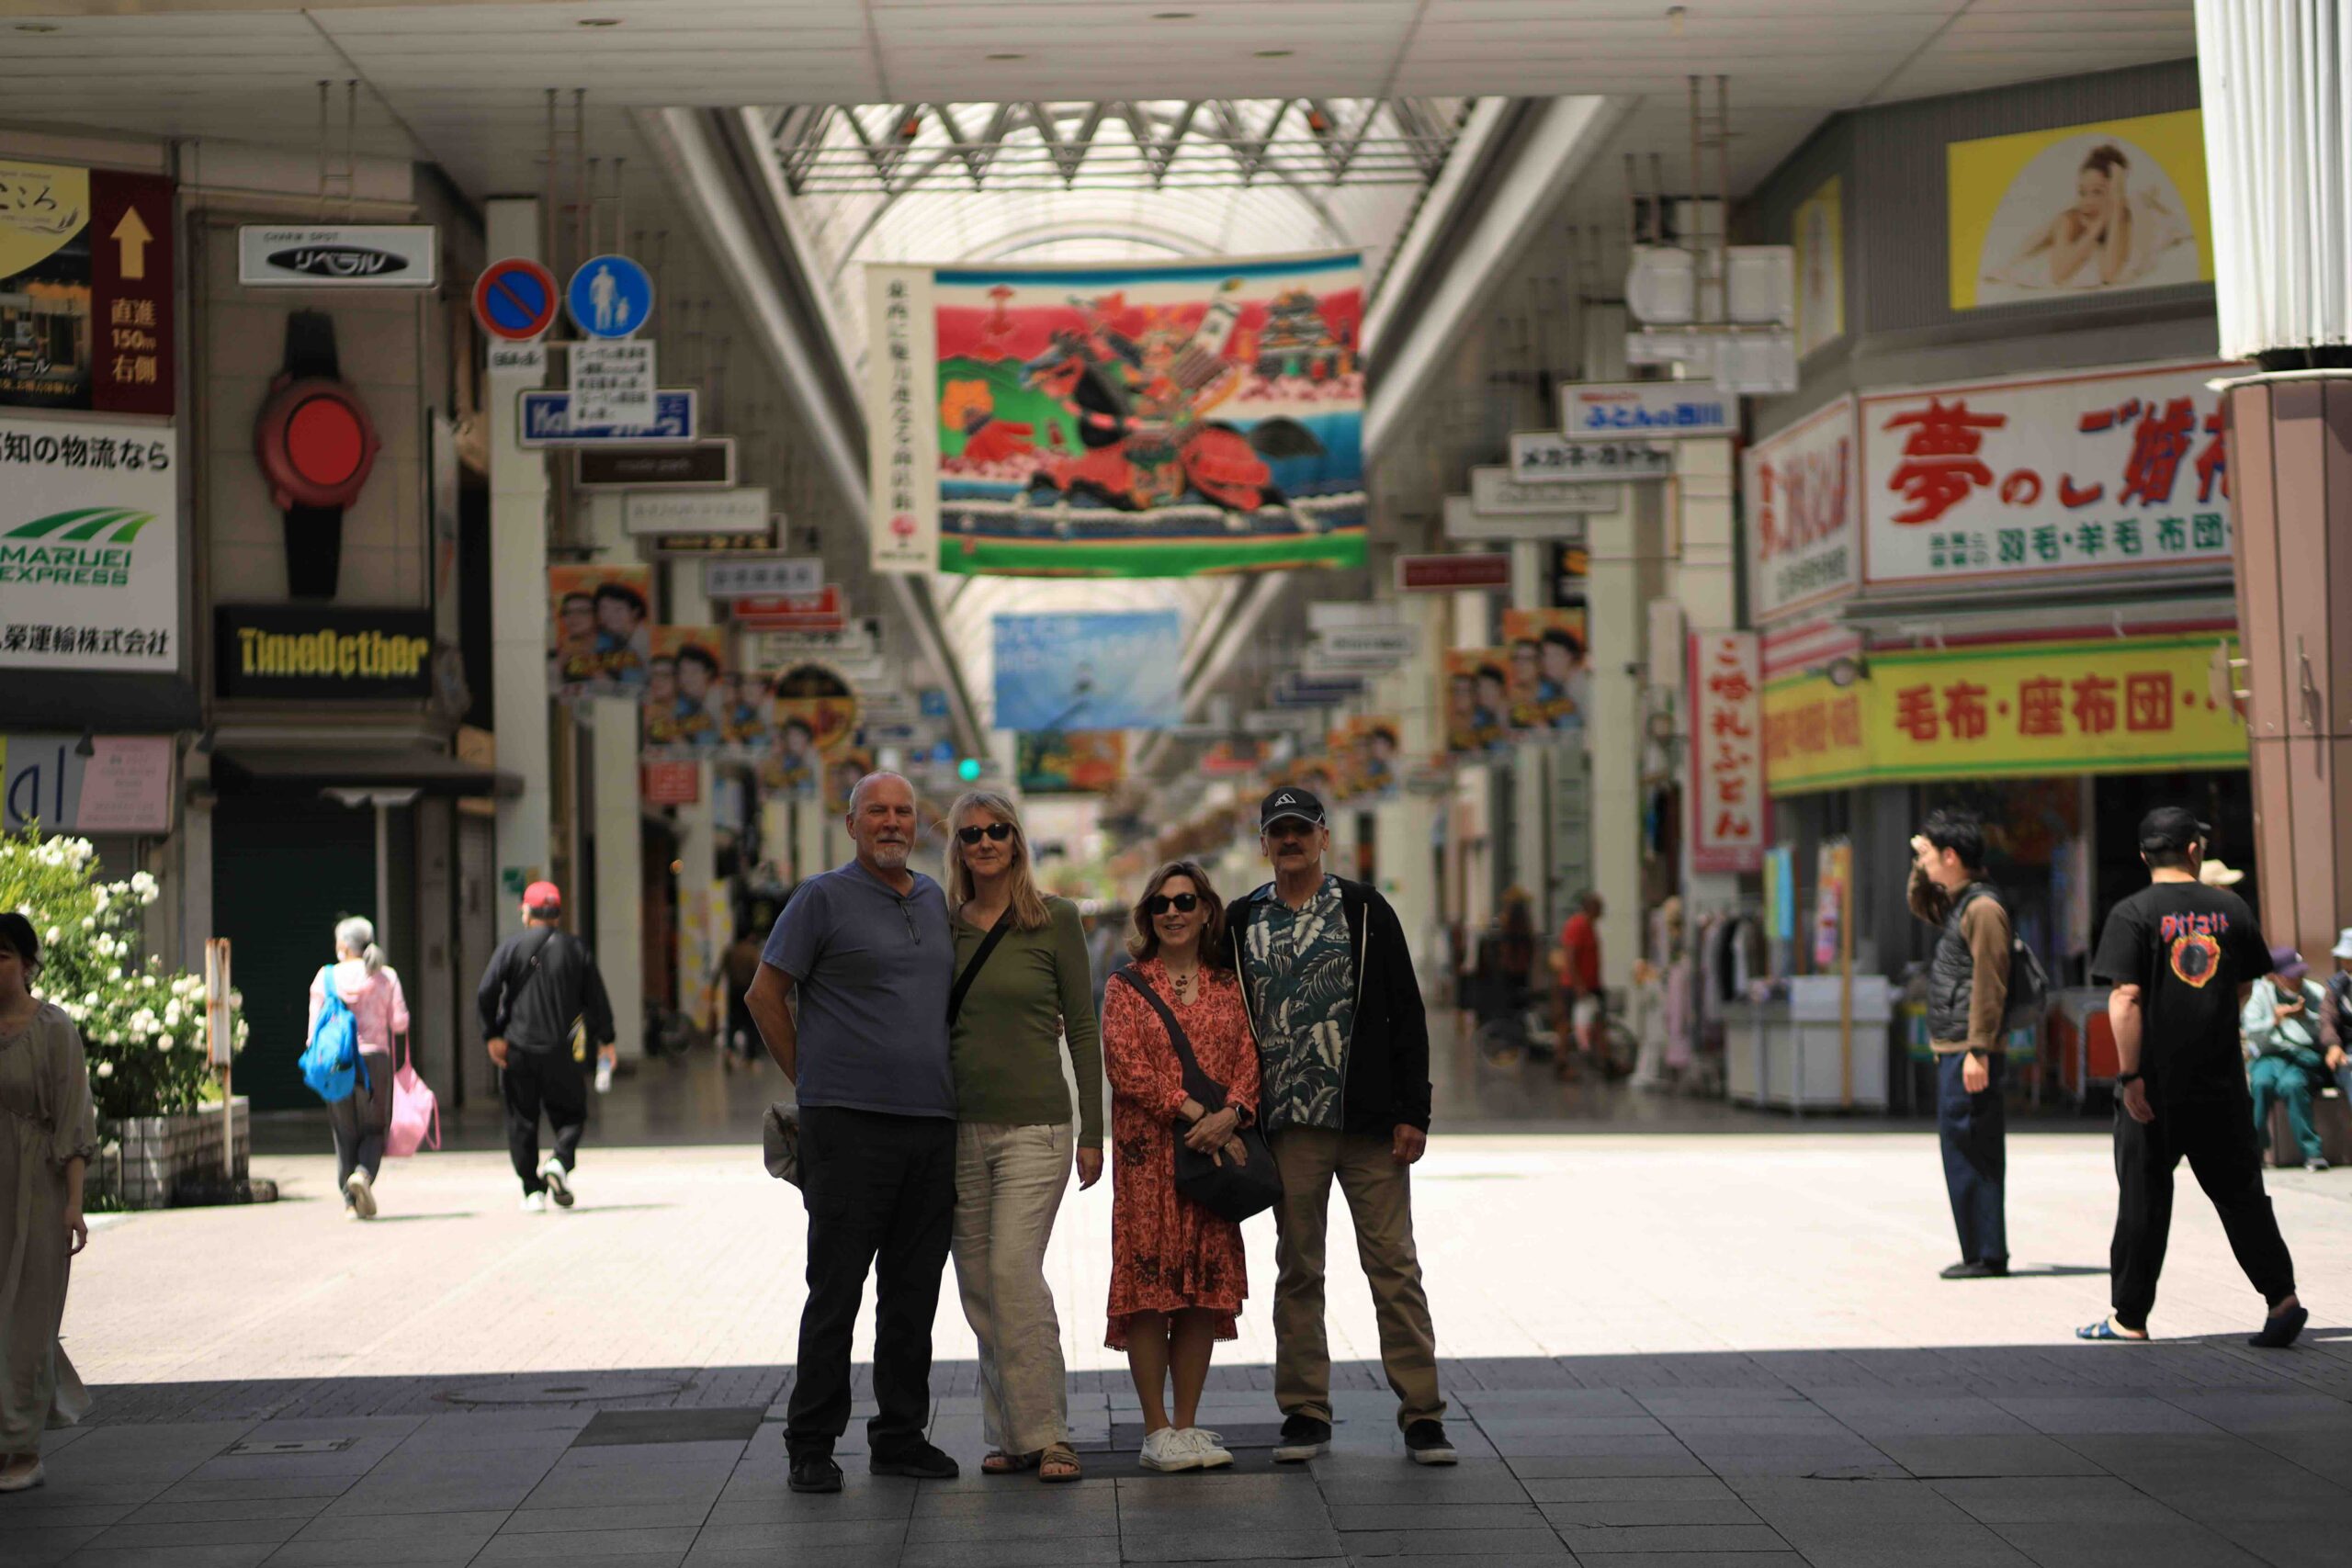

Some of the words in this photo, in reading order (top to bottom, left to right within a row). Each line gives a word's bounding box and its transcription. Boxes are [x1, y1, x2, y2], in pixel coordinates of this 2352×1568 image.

[111, 298, 156, 324] 直進
[112, 328, 156, 350] 150m
[113, 354, 157, 384] 右側
[1584, 401, 1724, 428] ふとんの西川
[0, 430, 169, 471] 知の物流なら
[0, 544, 132, 569] MARUEI
[0, 564, 130, 587] EXPRESS
[0, 623, 169, 657] 榮運輸株式会社
